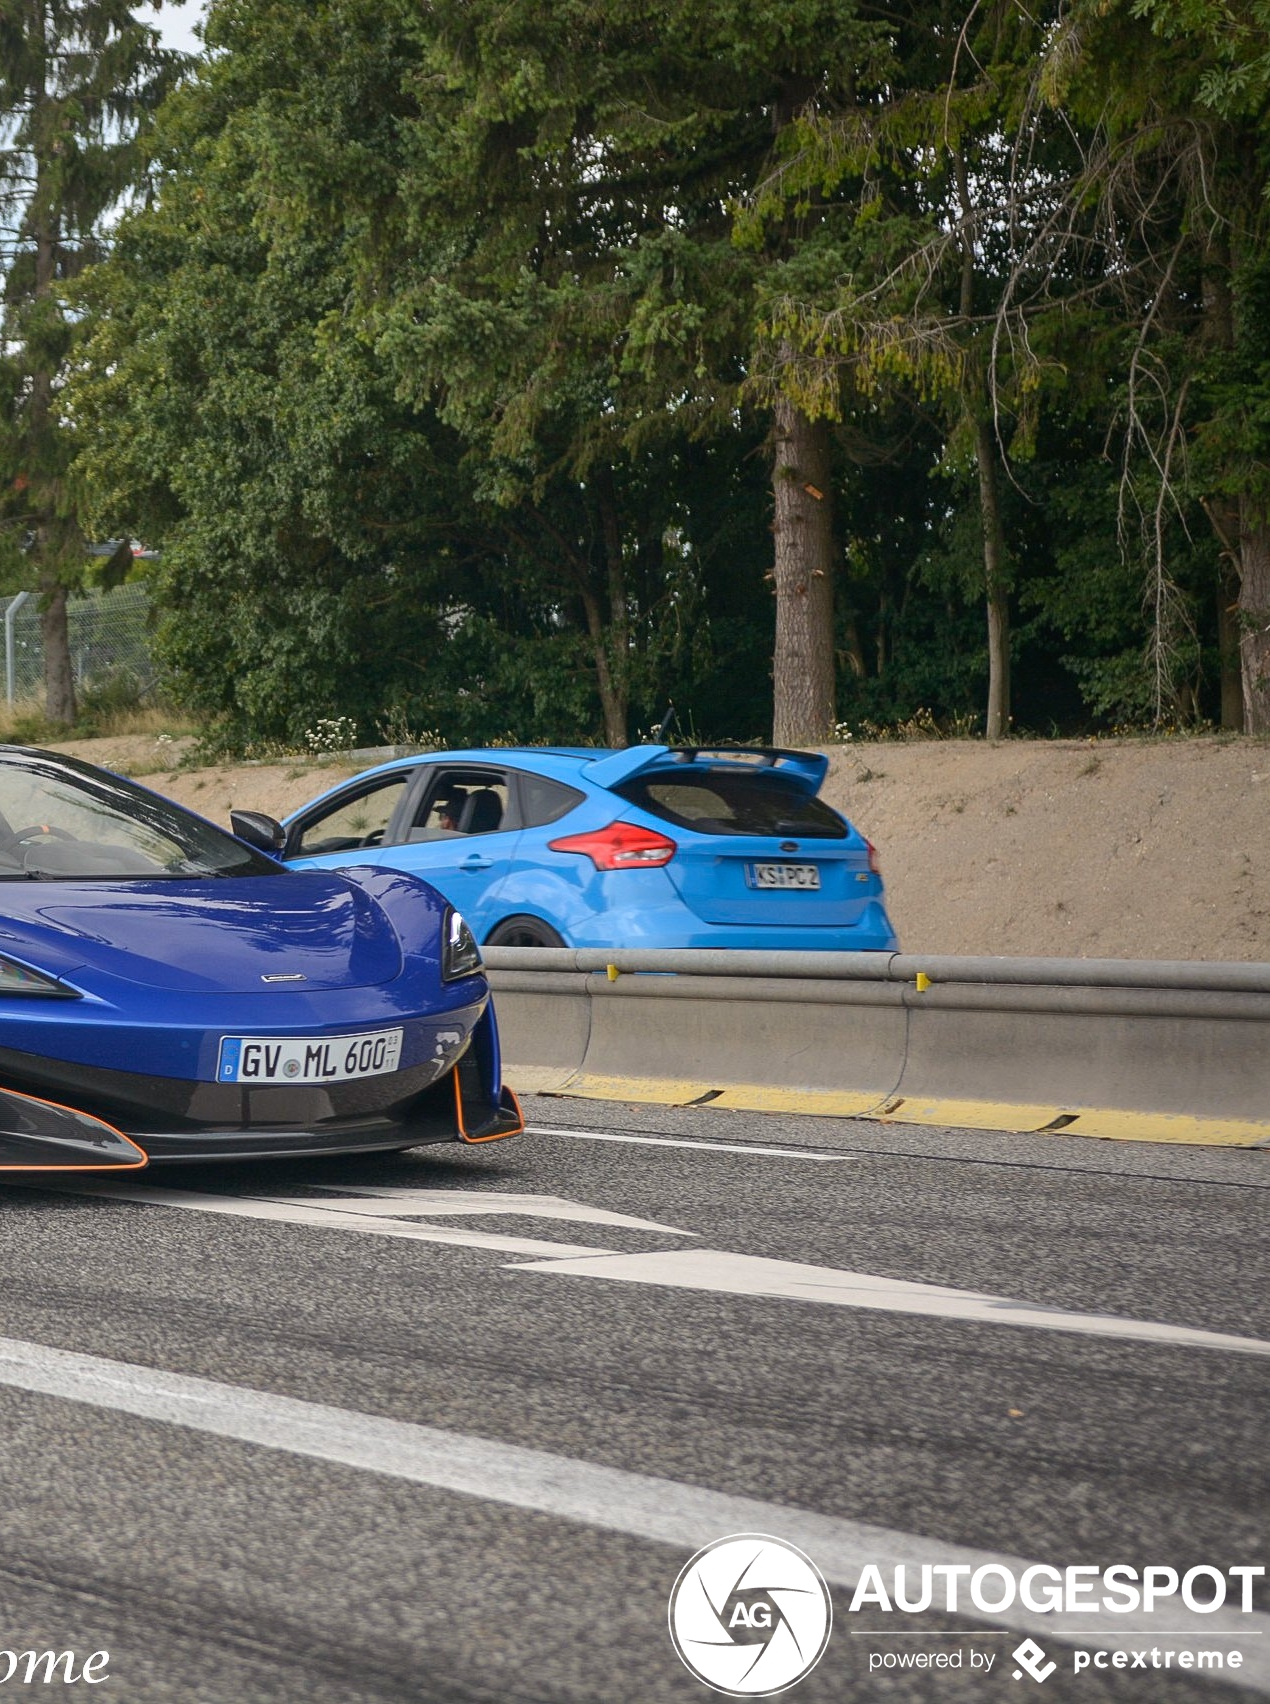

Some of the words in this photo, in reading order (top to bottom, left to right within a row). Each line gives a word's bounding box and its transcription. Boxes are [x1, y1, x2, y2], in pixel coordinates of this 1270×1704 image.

[242, 1044, 281, 1077] GV
[303, 1044, 337, 1077] ML
[344, 1037, 386, 1074] 600
[224, 1065, 233, 1075] D
